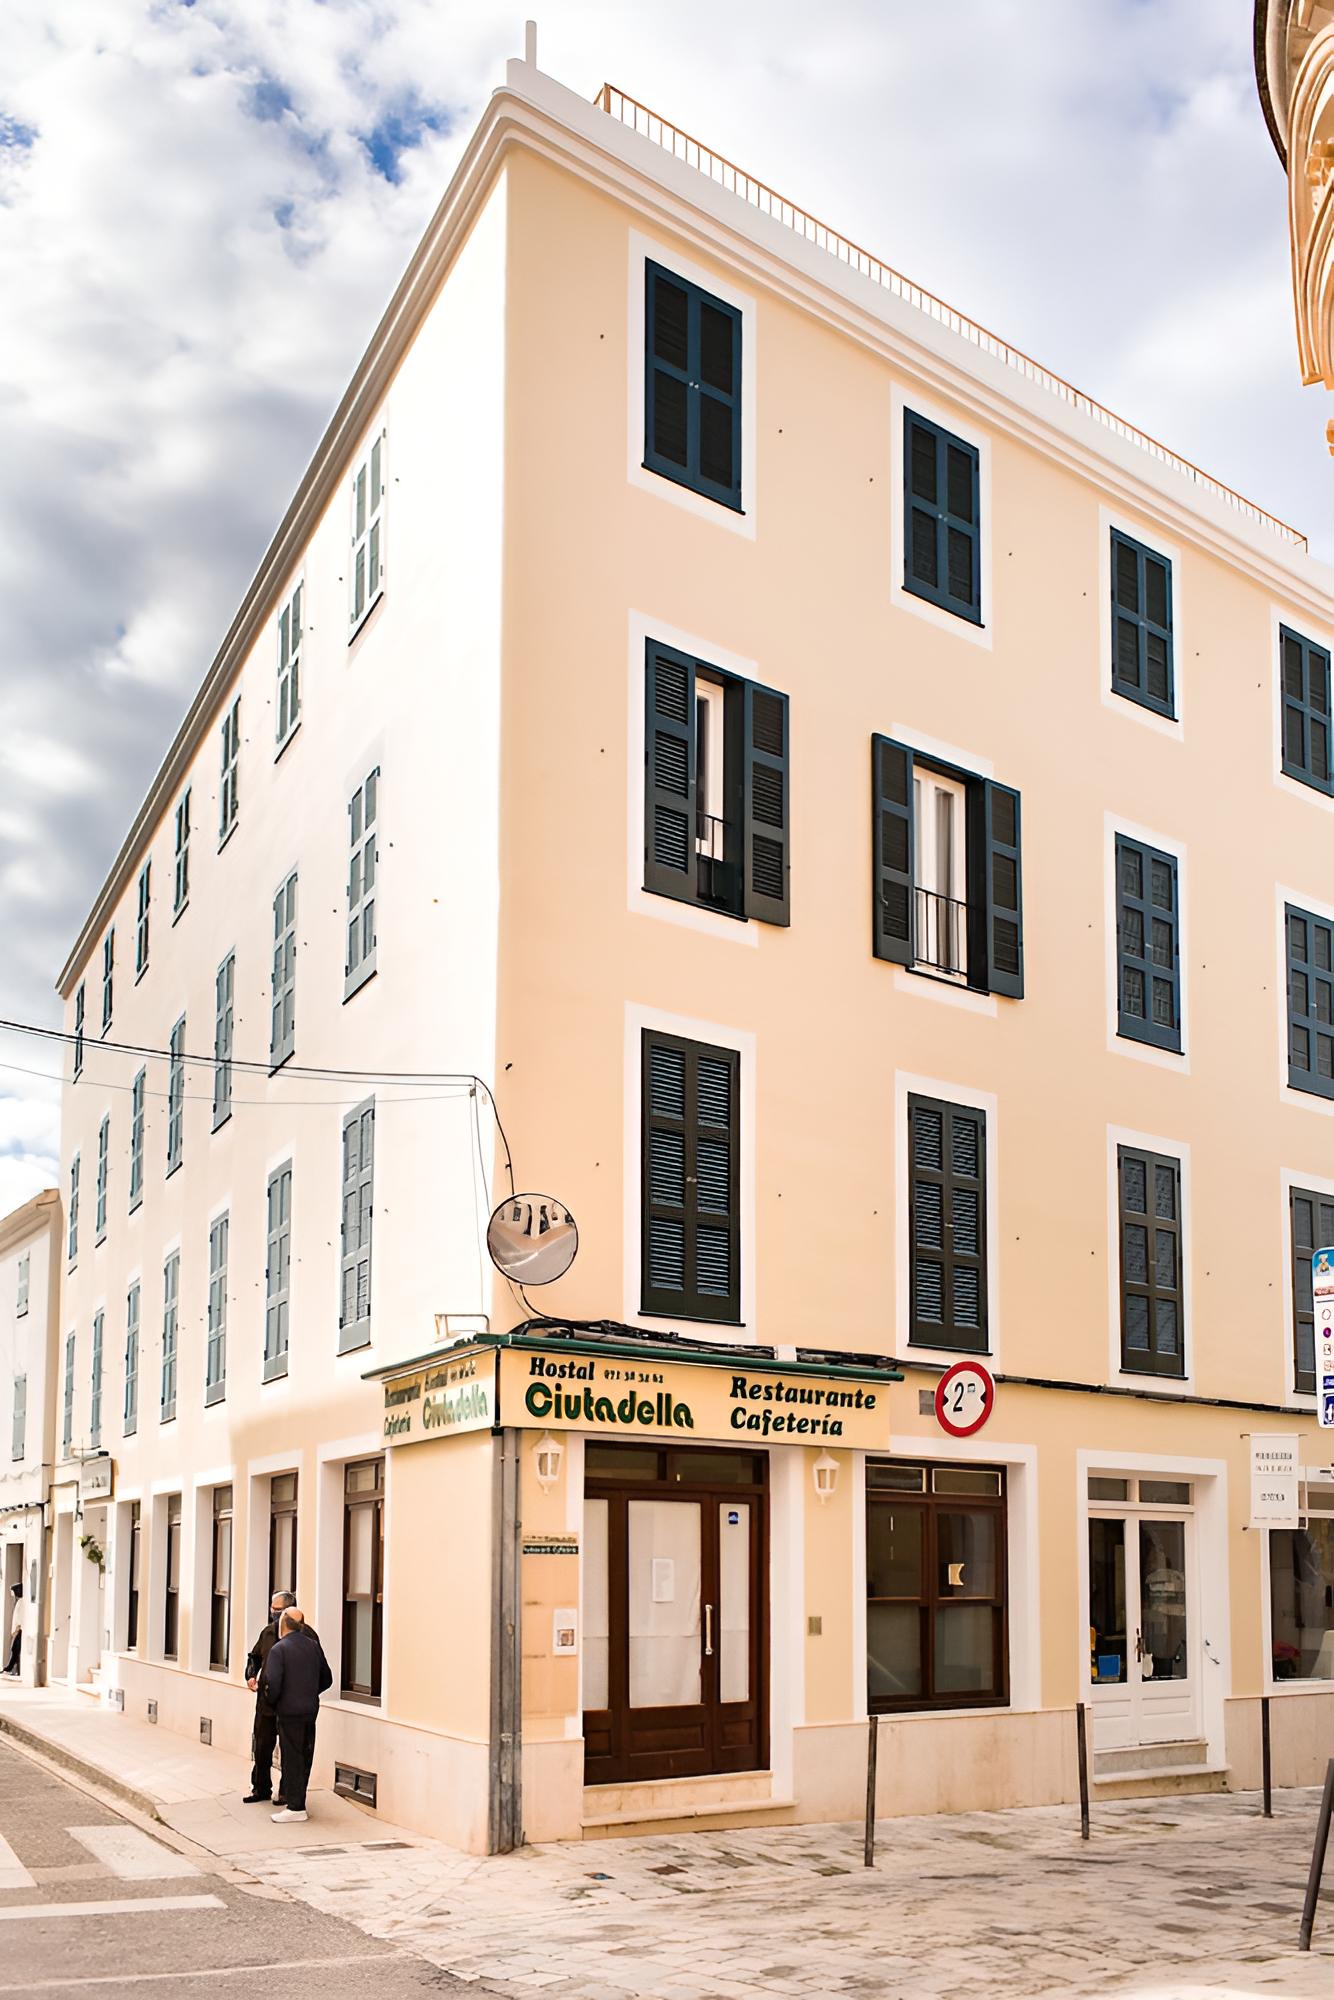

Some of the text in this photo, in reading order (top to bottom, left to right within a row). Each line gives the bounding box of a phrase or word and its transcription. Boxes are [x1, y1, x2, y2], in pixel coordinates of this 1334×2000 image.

[529, 1356, 596, 1380] Hostal
[525, 1382, 694, 1429] Ciutadella
[730, 1376, 876, 1409] Restaurante
[730, 1406, 843, 1436] Cafetería
